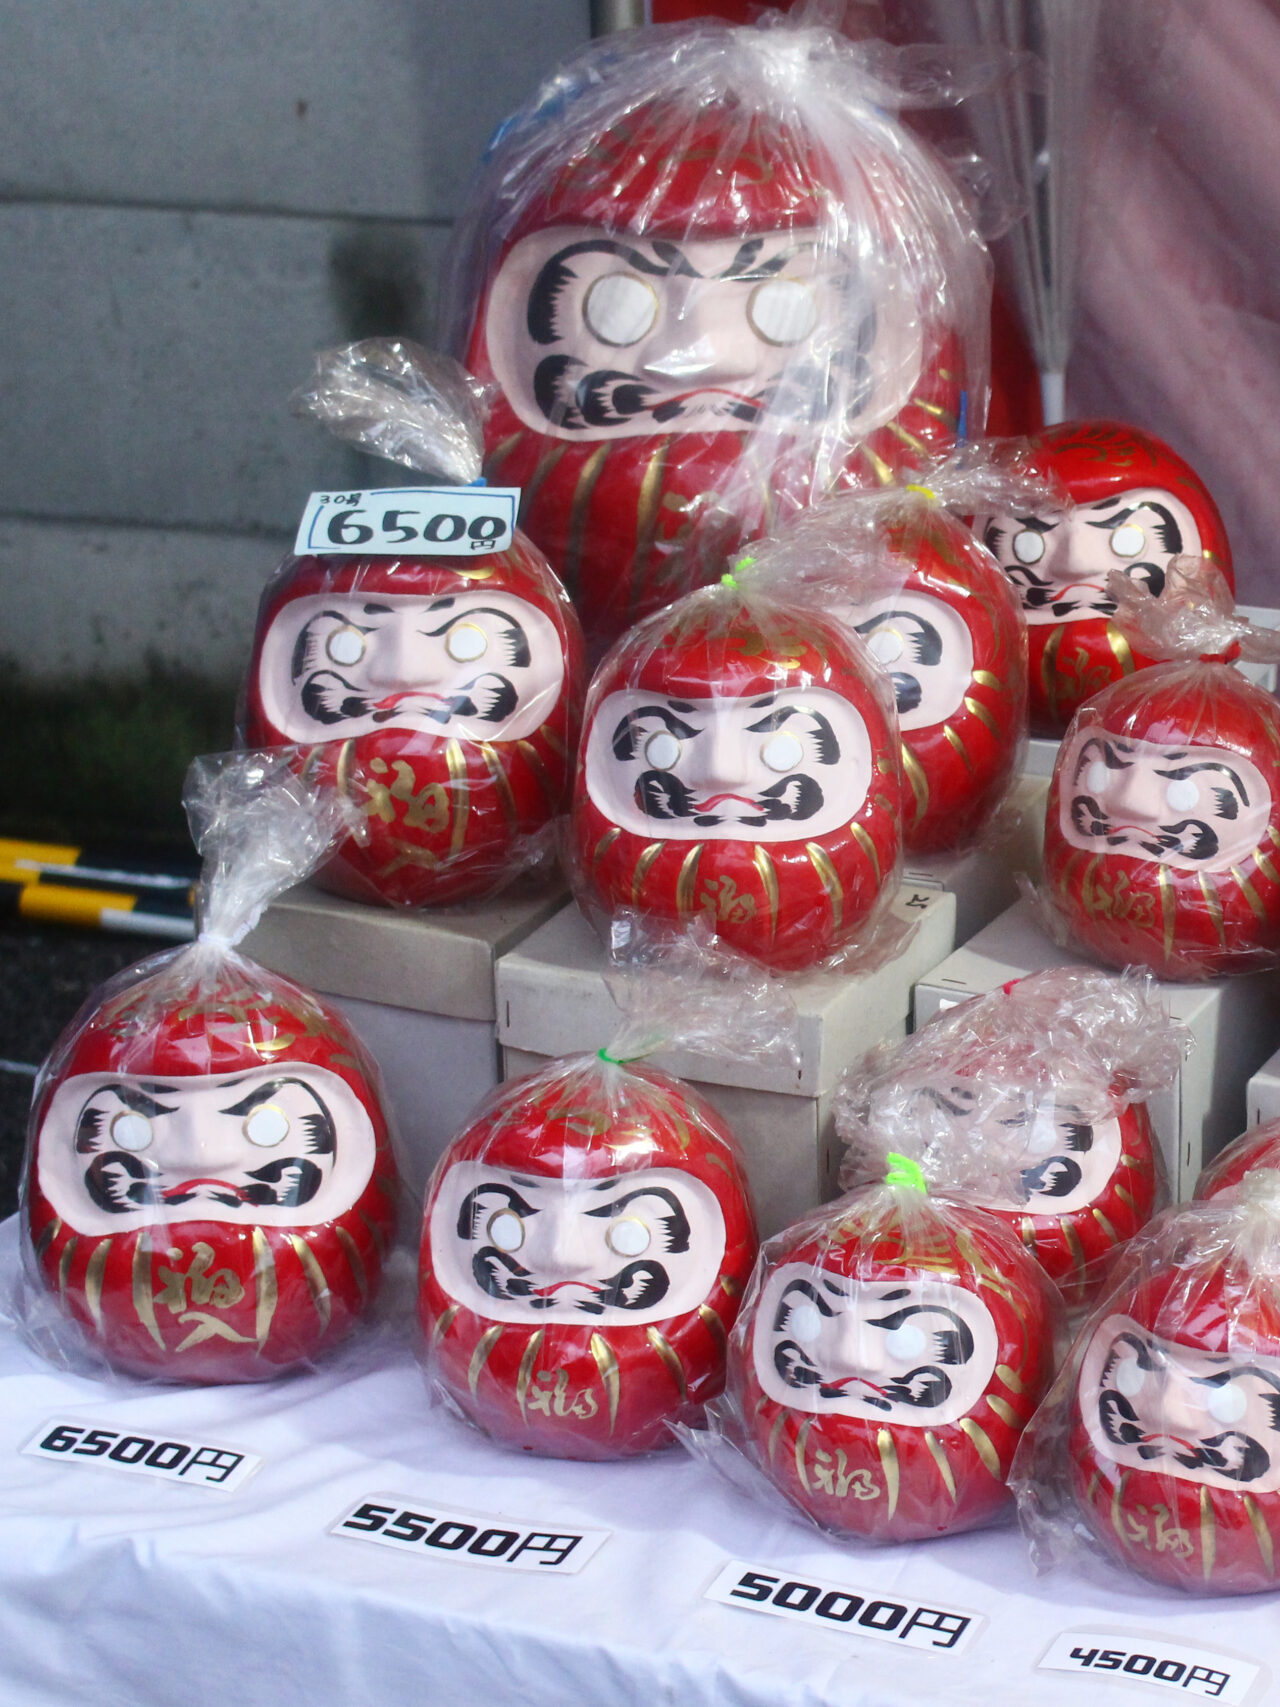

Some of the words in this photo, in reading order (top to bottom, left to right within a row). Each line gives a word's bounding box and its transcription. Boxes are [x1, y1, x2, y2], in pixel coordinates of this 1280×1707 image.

[39, 1425, 245, 1483] 6500円
[343, 1502, 583, 1566] 5500円
[730, 1571, 972, 1649] 5000円
[1069, 1647, 1231, 1697] 4500円
